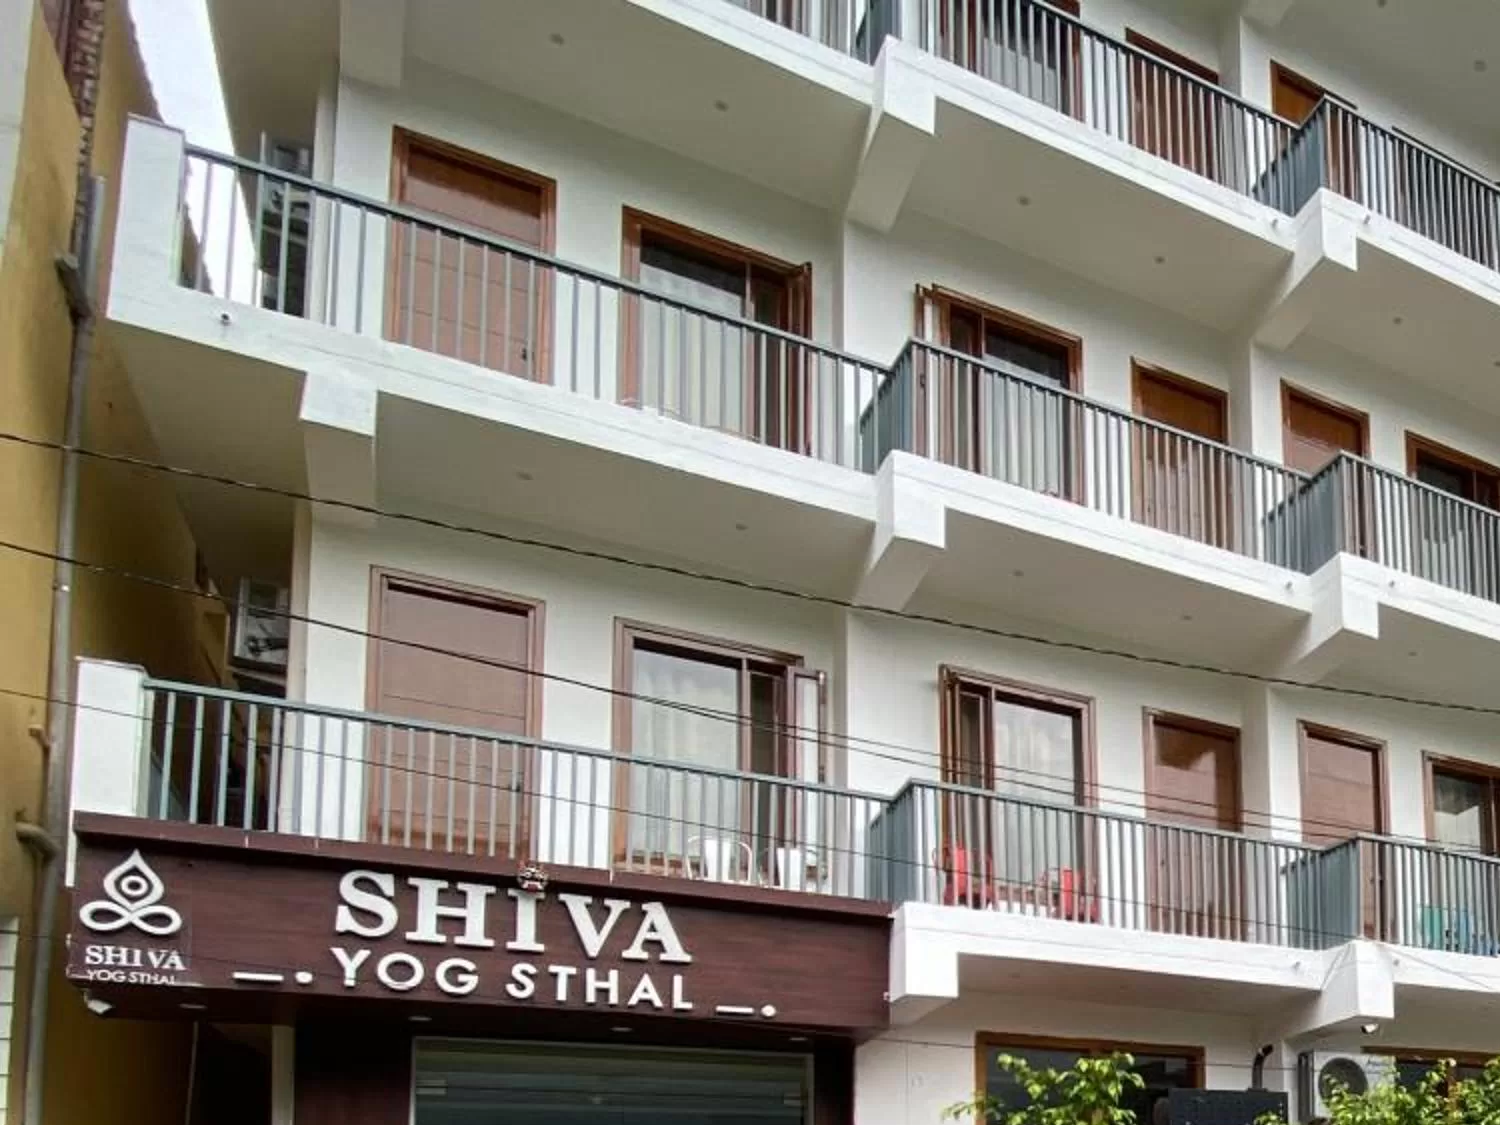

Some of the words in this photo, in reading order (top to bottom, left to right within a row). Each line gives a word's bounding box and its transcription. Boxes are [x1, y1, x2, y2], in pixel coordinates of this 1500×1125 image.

[335, 870, 694, 963] SHIVA
[84, 944, 188, 971] SHIVA
[86, 969, 127, 983] YOG
[330, 946, 479, 994] YOG
[505, 962, 695, 1010] STHAL
